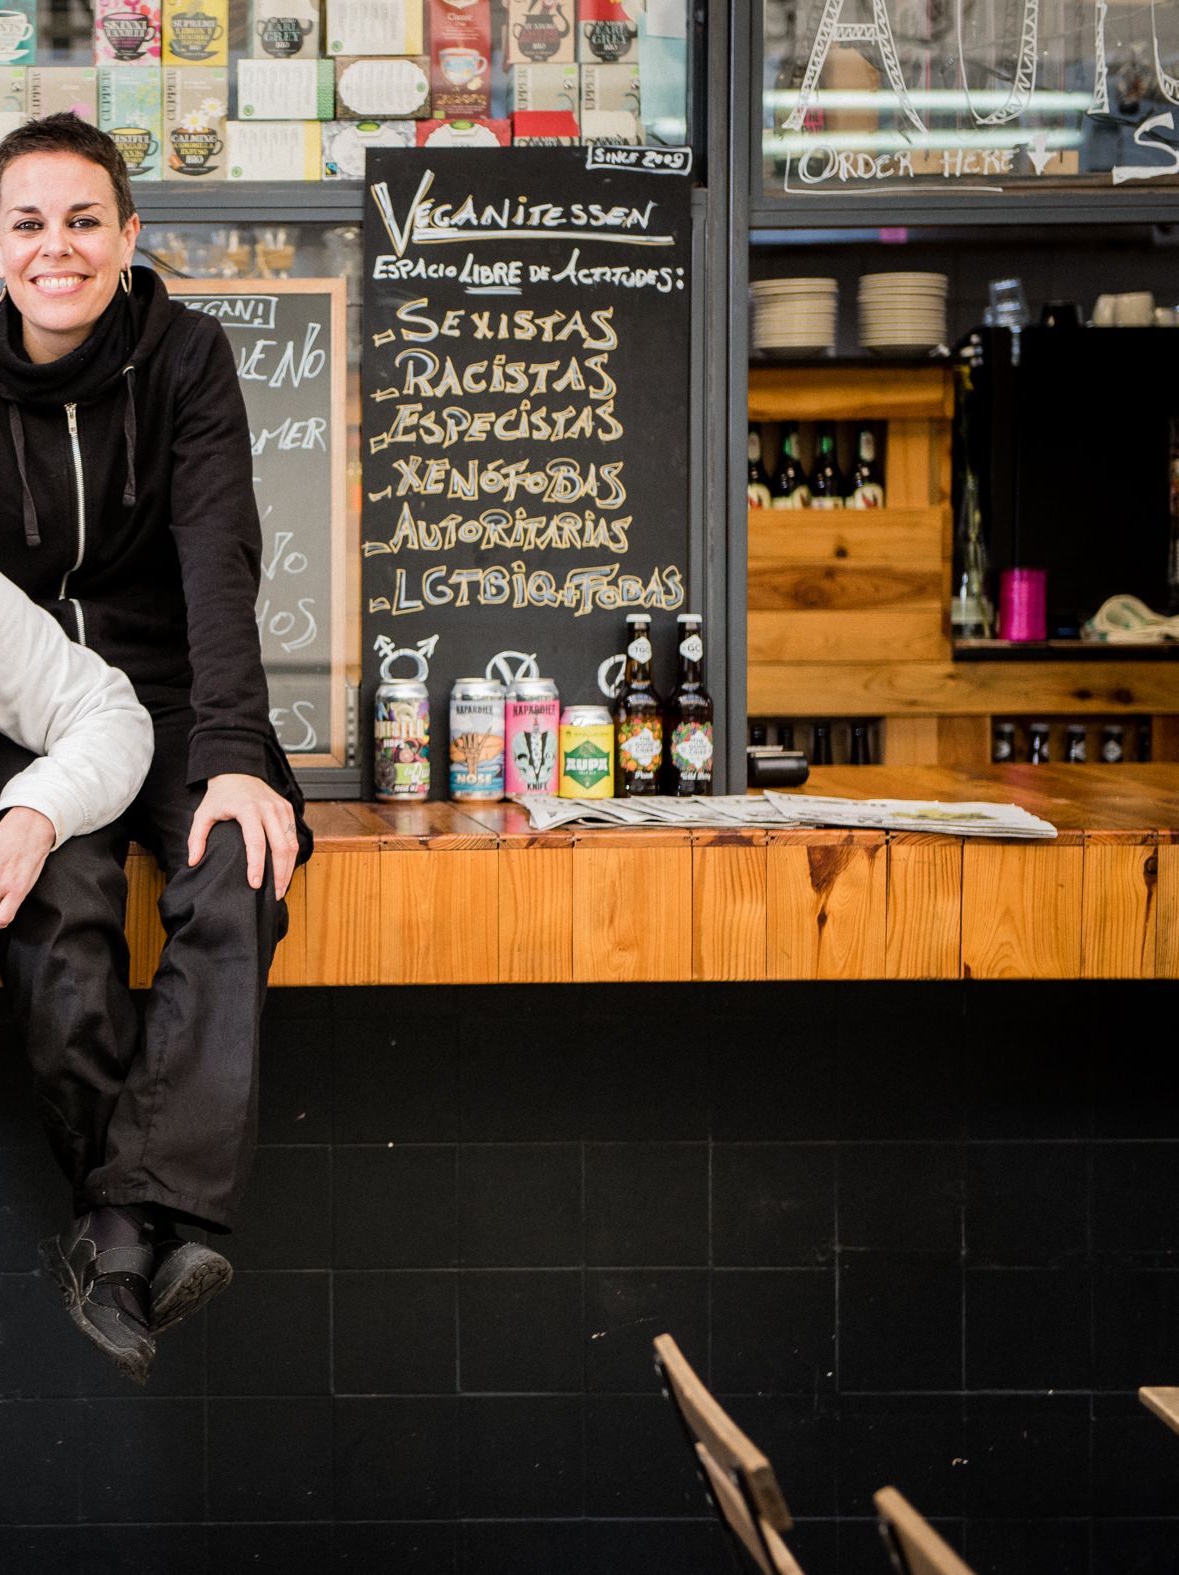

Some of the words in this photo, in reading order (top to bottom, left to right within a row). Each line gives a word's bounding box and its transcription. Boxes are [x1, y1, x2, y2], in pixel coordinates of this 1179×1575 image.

[594, 149, 639, 165] SINCE
[640, 150, 685, 169] 2009
[798, 145, 915, 184] ORDER
[939, 146, 1020, 178] HERE
[372, 255, 457, 281] ESPACIO
[458, 252, 523, 286] LIBRE
[529, 265, 551, 283] DE
[183, 299, 265, 326] EGAN!
[396, 297, 618, 351] SEXISTAS
[395, 347, 617, 400] RACISTAS
[387, 398, 624, 449] ESPECISTAS
[389, 501, 633, 554] AUTORITARIAS
